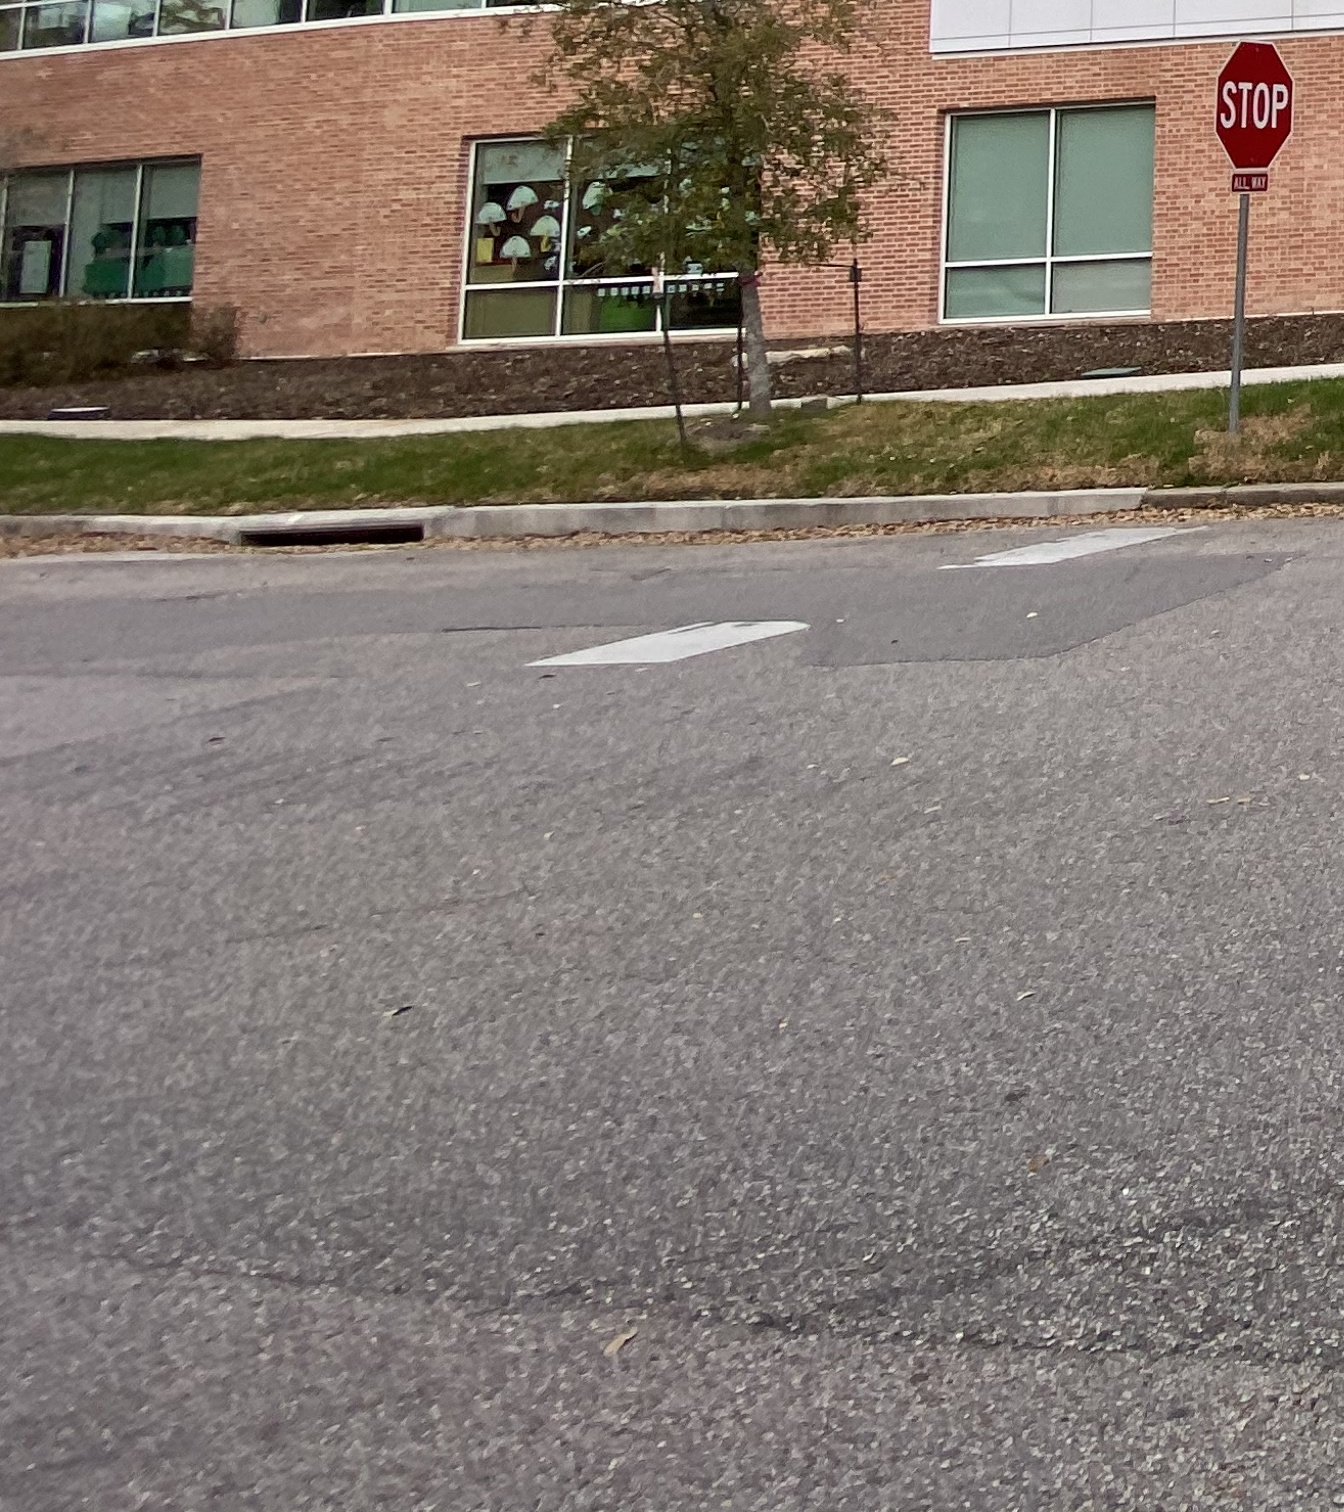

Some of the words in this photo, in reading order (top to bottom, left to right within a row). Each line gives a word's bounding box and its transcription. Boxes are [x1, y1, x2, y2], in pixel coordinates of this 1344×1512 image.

[1220, 80, 1289, 129] STOP
[1233, 176, 1250, 190] ALL
[1251, 176, 1267, 189] WAY
